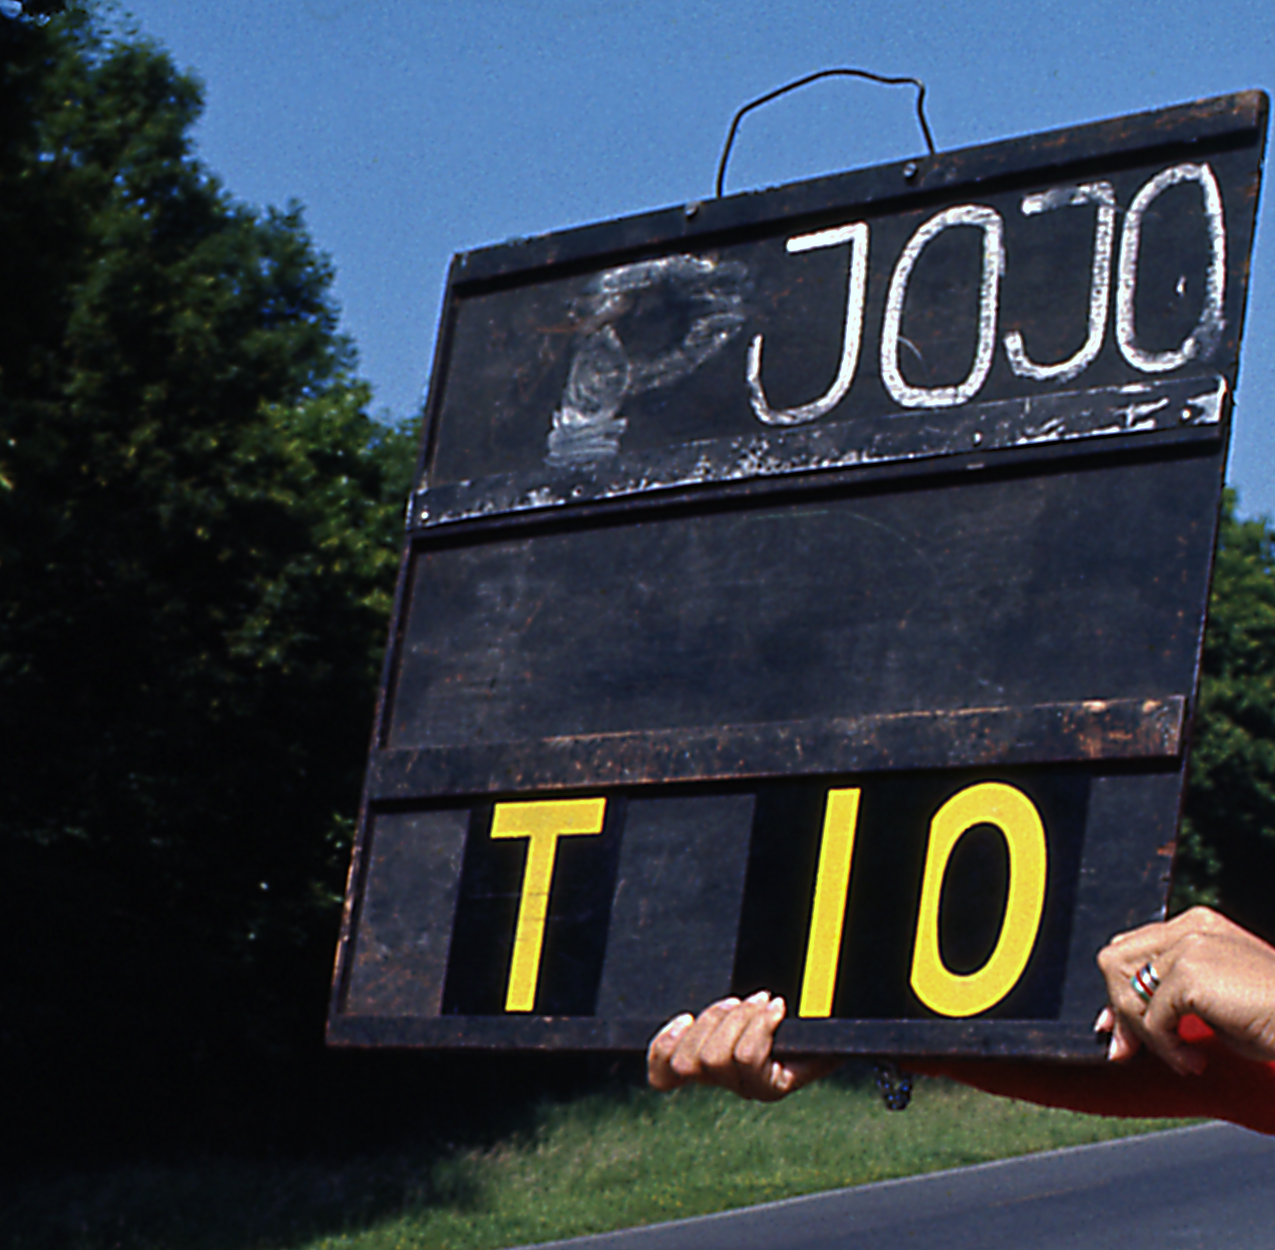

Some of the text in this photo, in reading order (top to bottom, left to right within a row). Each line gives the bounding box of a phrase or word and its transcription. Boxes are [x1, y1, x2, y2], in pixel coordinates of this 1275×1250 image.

[745, 162, 1227, 426] JOJO
[490, 782, 1047, 1018] T 10
